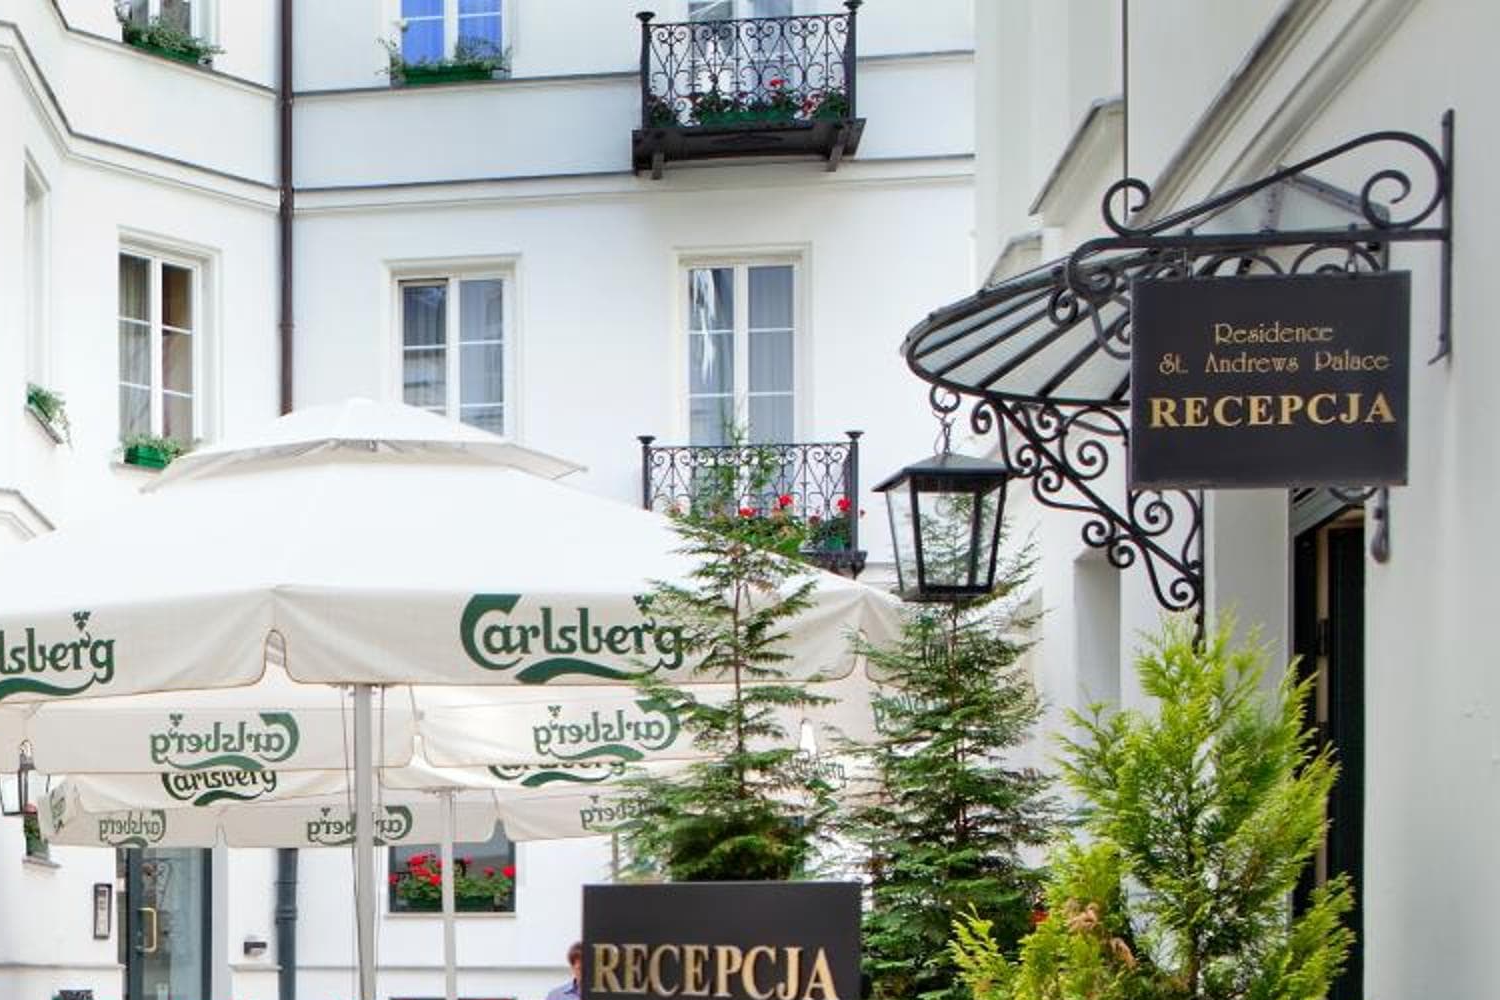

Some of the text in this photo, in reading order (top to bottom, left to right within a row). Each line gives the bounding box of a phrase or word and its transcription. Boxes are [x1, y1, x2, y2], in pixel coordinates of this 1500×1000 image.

[1214, 323, 1334, 345] Residence
[1204, 351, 1299, 374] Andrews
[1314, 348, 1390, 372] Palace
[1149, 392, 1397, 429] RECEPCJA
[457, 593, 684, 672] Carlsberg
